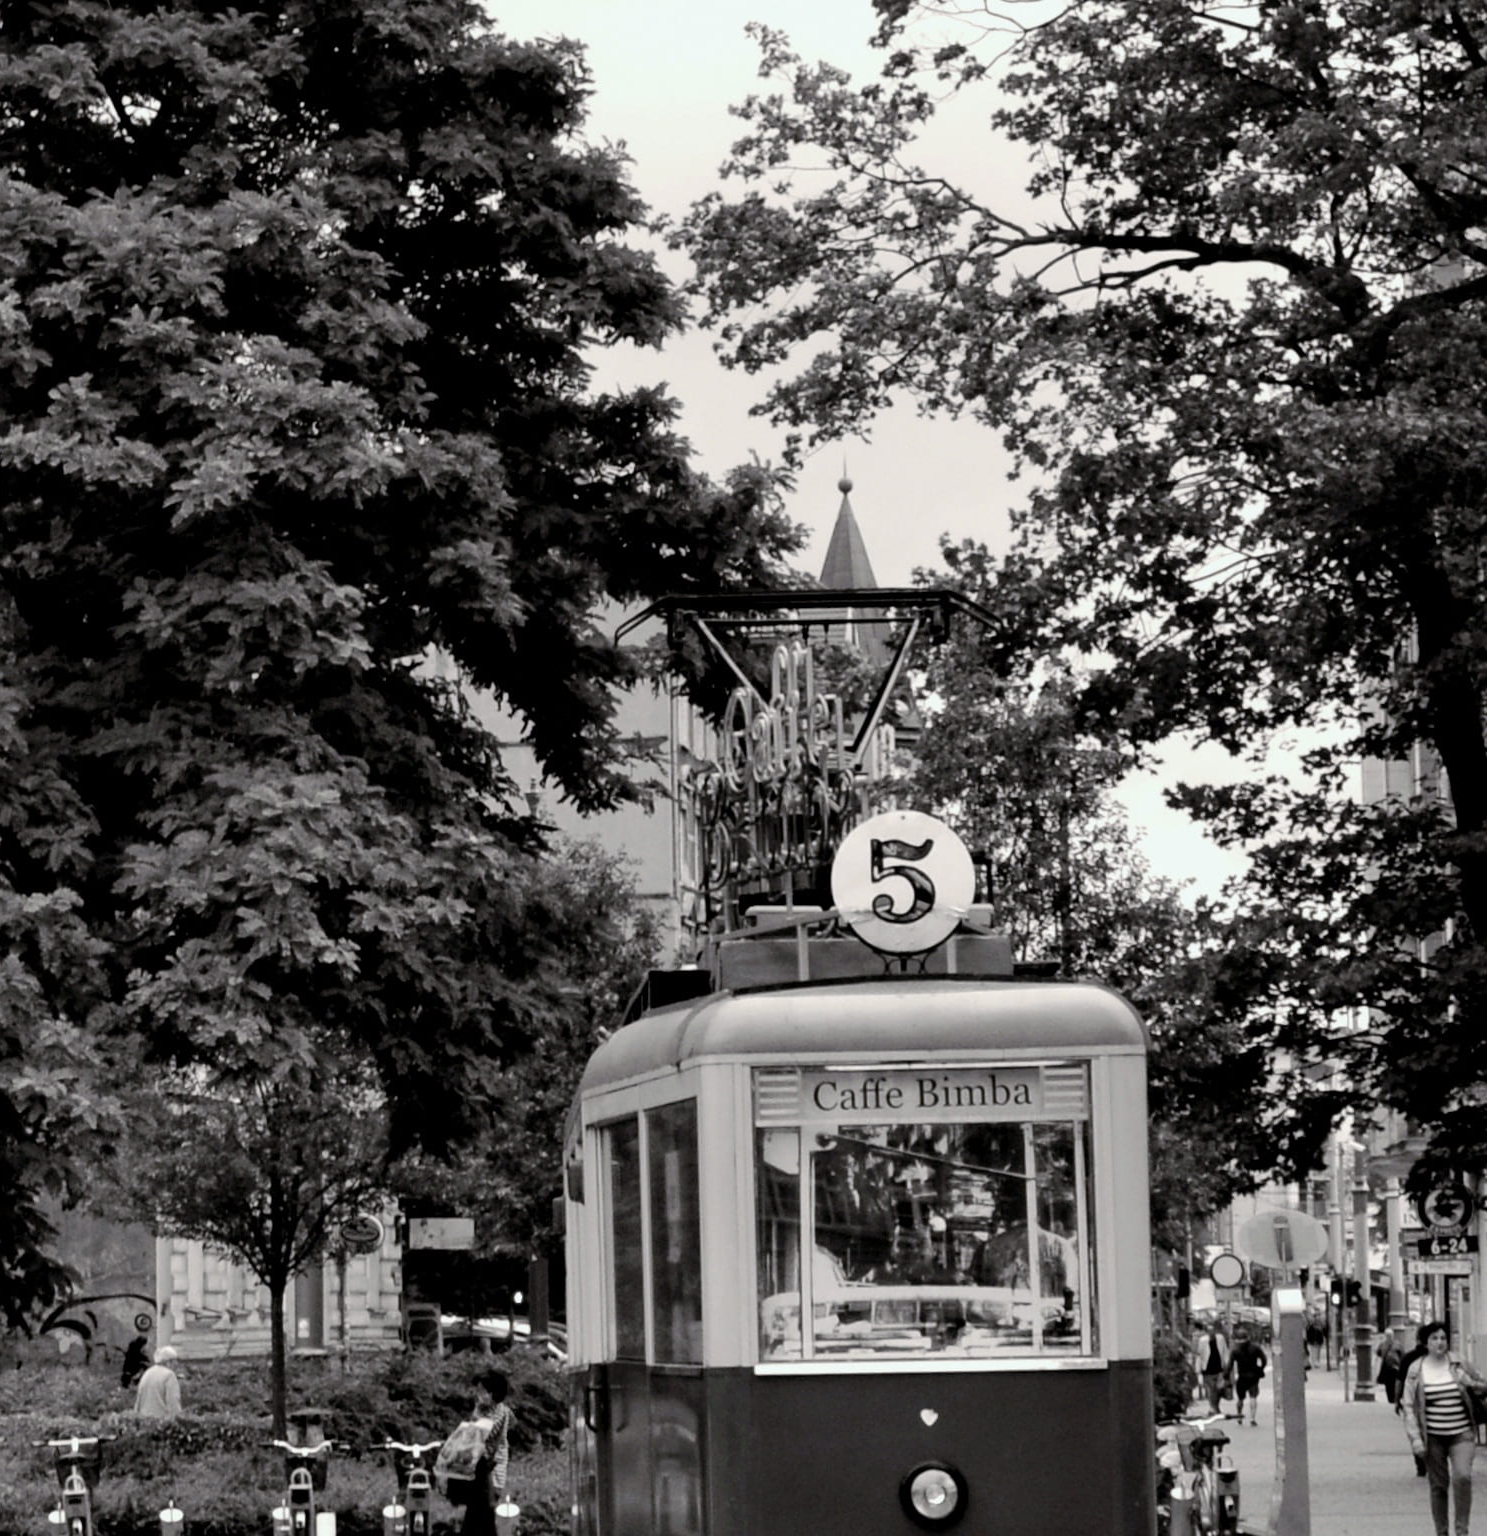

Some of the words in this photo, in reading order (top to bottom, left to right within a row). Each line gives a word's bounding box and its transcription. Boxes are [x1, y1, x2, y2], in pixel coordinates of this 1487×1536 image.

[870, 838, 936, 925] 5
[813, 1077, 904, 1112] Caffe
[916, 1073, 1033, 1109] Bimba
[1430, 1237, 1469, 1255] 6-24
